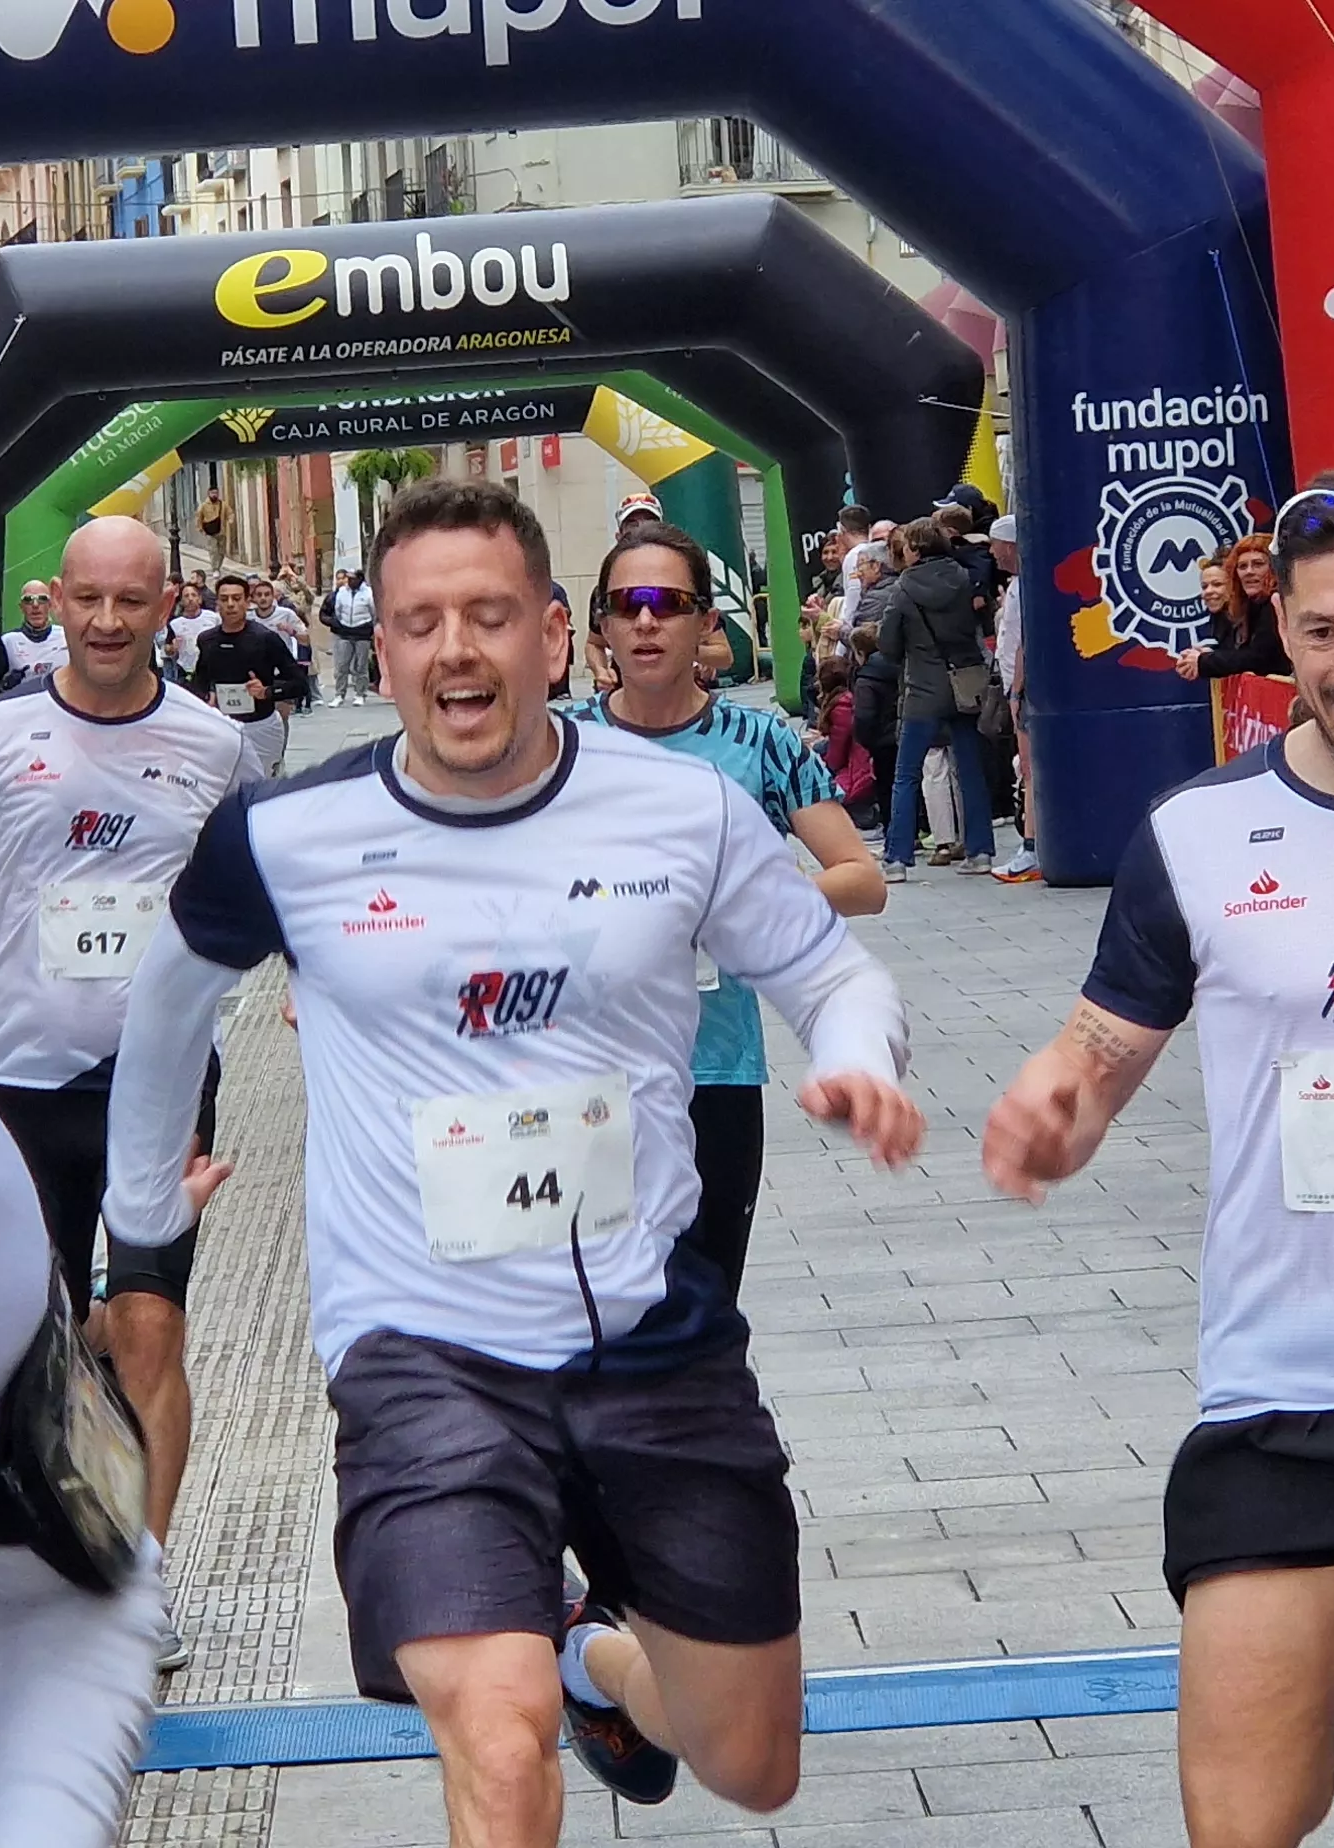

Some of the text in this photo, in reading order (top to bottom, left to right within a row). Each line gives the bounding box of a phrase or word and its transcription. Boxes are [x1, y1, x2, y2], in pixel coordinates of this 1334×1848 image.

[214, 232, 570, 329] embou
[220, 327, 572, 367] PÁSATE A LA OPERADORA ARAGONESA
[271, 401, 556, 441] CAJA RURAL DE ARAGÓN
[1071, 384, 1269, 433] fundación
[1107, 427, 1235, 478] mupol
[1122, 516, 1147, 572] Fundación
[1145, 506, 1160, 519] de
[1160, 501, 1173, 512] la
[1174, 499, 1229, 537] Mutualidad
[613, 875, 670, 899] mupol
[1224, 895, 1308, 918] Santander
[76, 931, 128, 954] 617
[506, 1167, 563, 1213] 44
